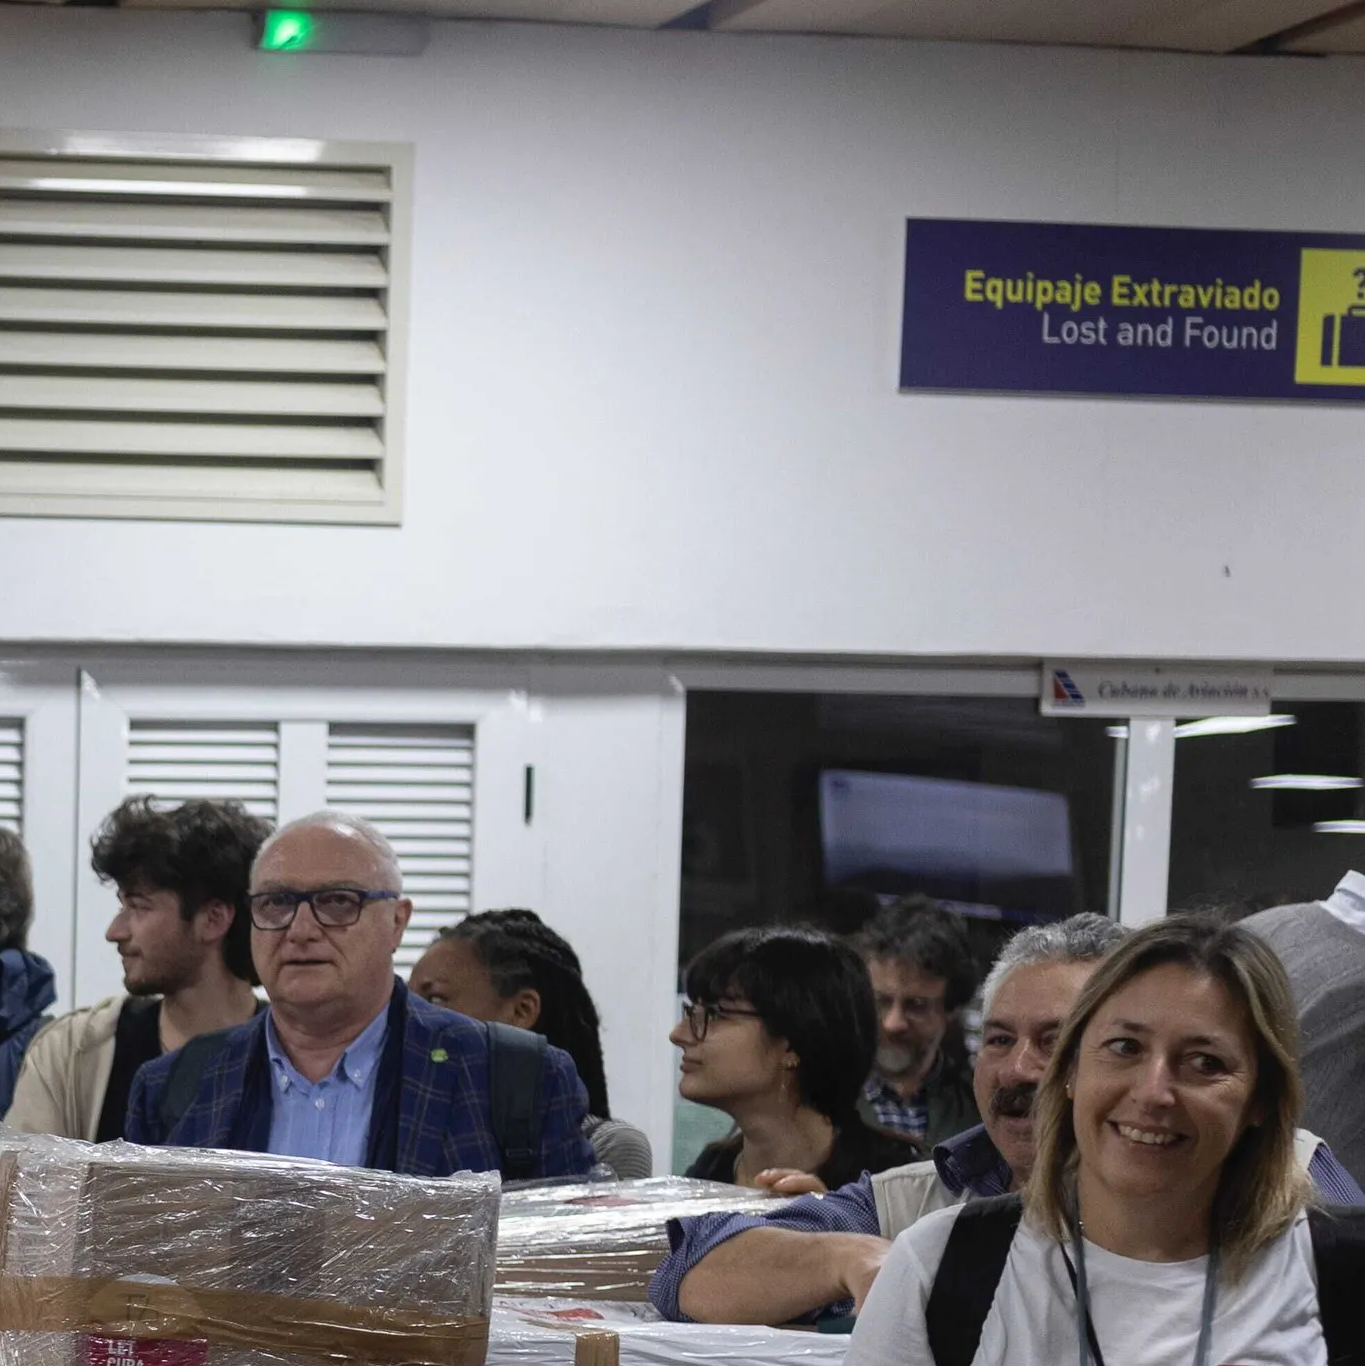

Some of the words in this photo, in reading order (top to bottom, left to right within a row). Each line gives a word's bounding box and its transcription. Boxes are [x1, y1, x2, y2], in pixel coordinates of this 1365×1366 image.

[963, 269, 1102, 312] Equipaje
[1111, 274, 1280, 311] Extraviado
[1042, 313, 1107, 346] Lost
[1117, 316, 1172, 347] and
[1184, 316, 1278, 350] Found
[107, 1340, 137, 1356] LET
